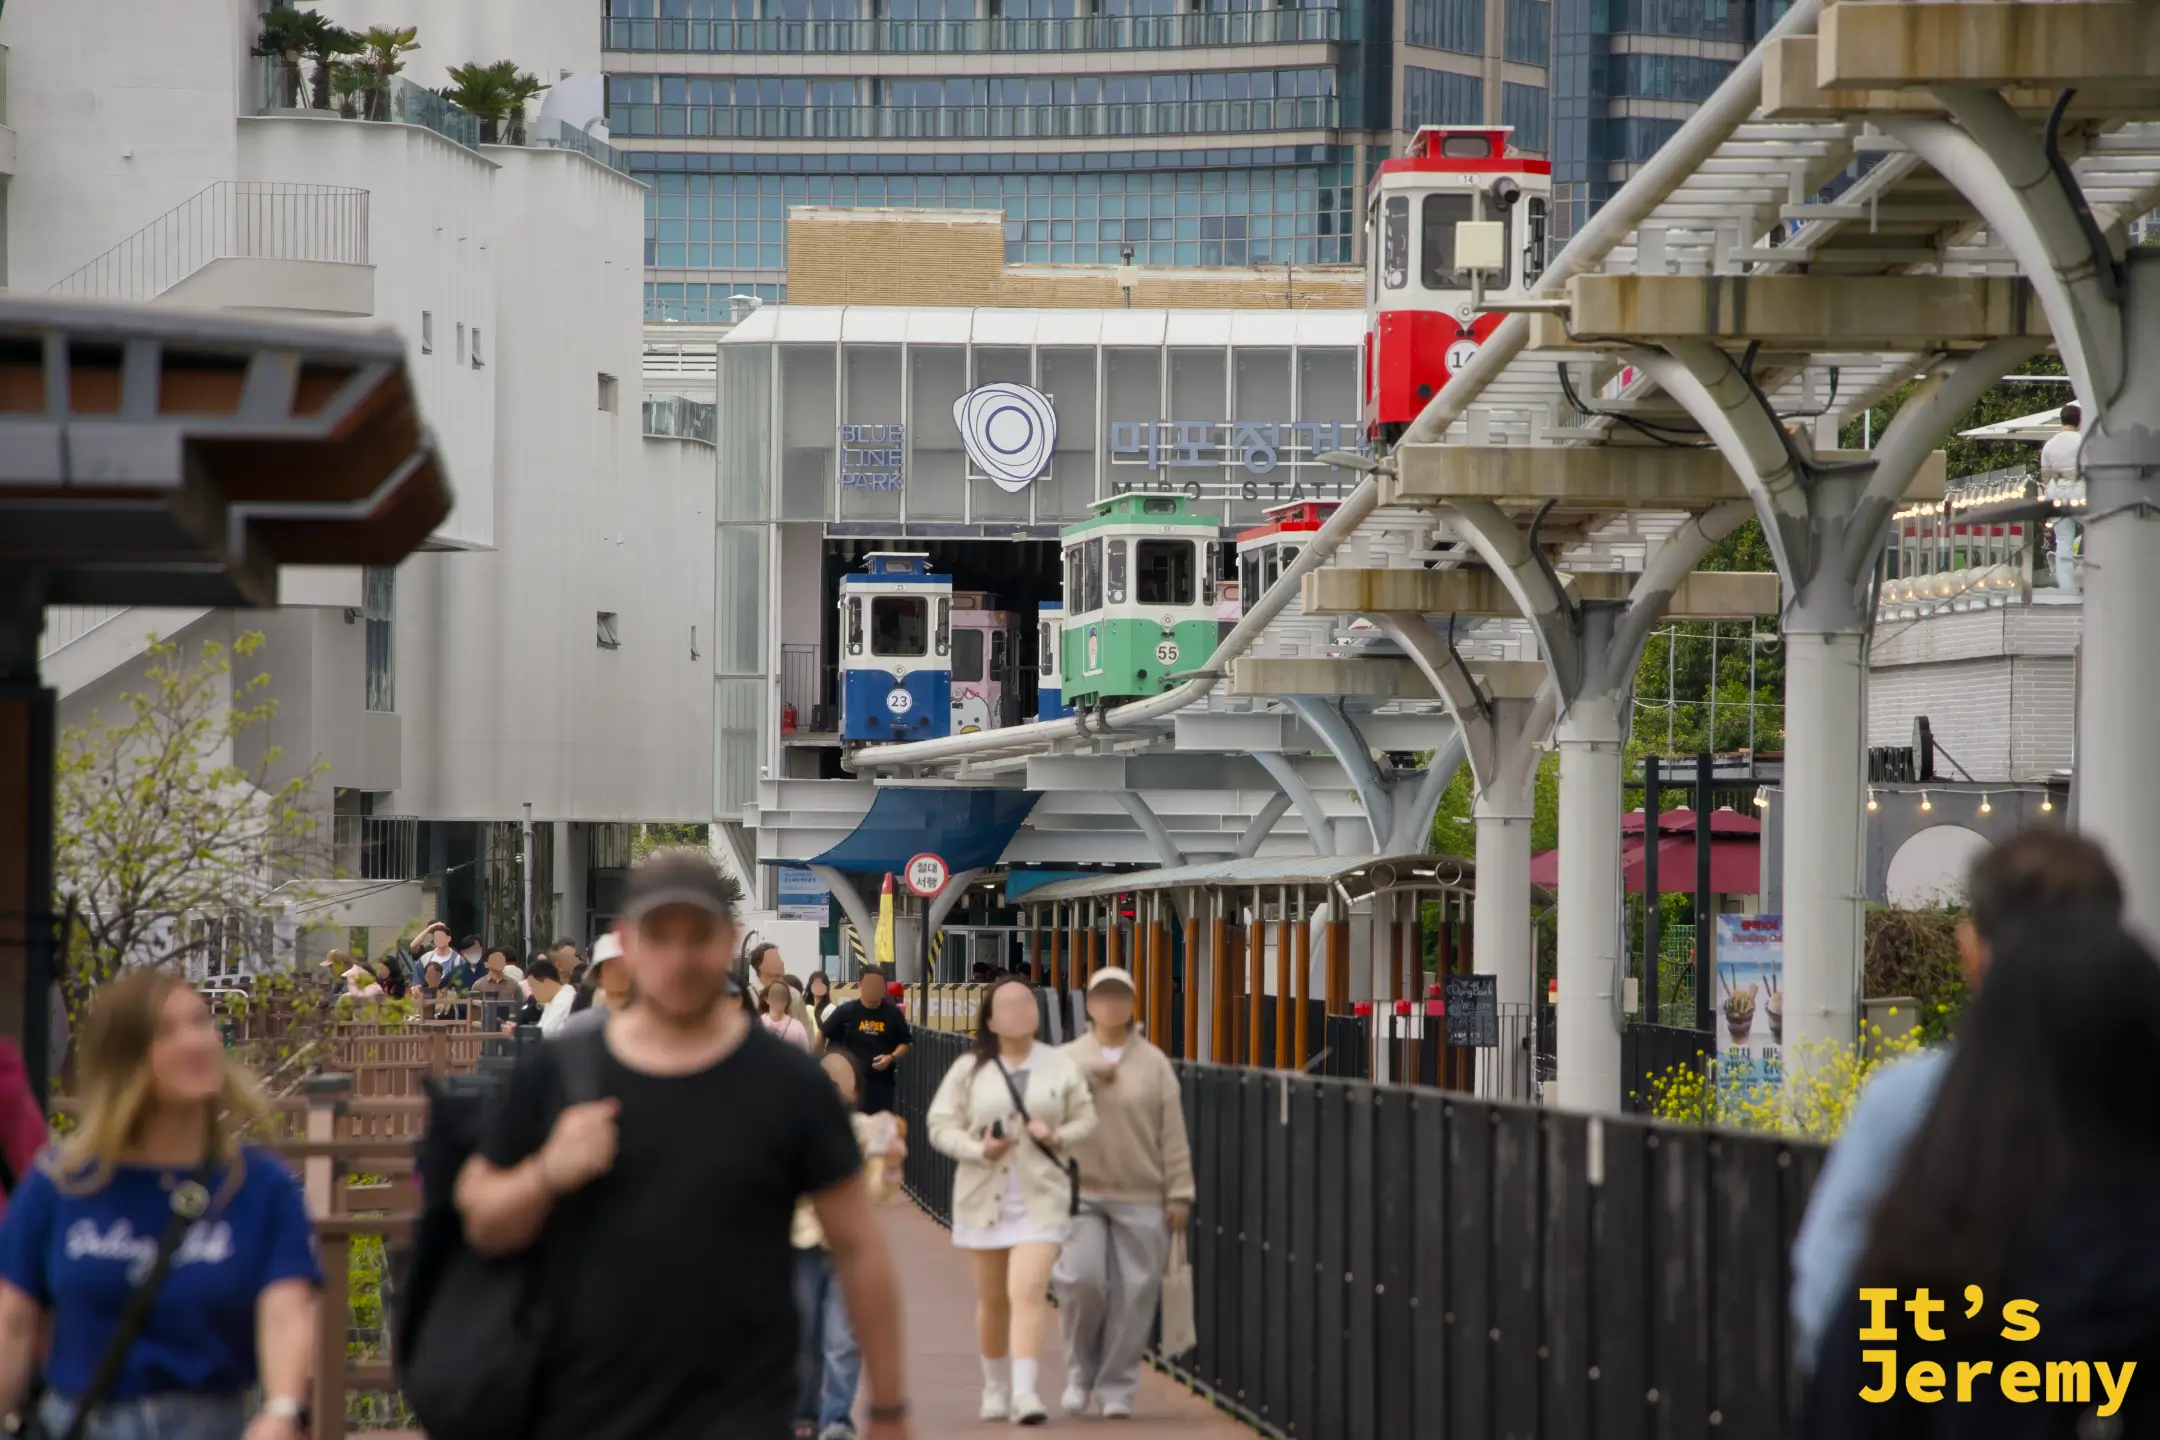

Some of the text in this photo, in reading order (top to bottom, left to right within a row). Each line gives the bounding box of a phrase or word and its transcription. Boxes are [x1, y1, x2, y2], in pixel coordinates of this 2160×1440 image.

[1462, 175, 1474, 185] 14
[840, 424, 904, 443] BLUE
[841, 448, 903, 468] LINE
[840, 472, 903, 492] PARK
[1242, 481, 1360, 501] STATI
[1157, 646, 1178, 660] 55
[891, 695, 908, 707] 23
[917, 862, 937, 873] 절대
[916, 876, 937, 888] 서행
